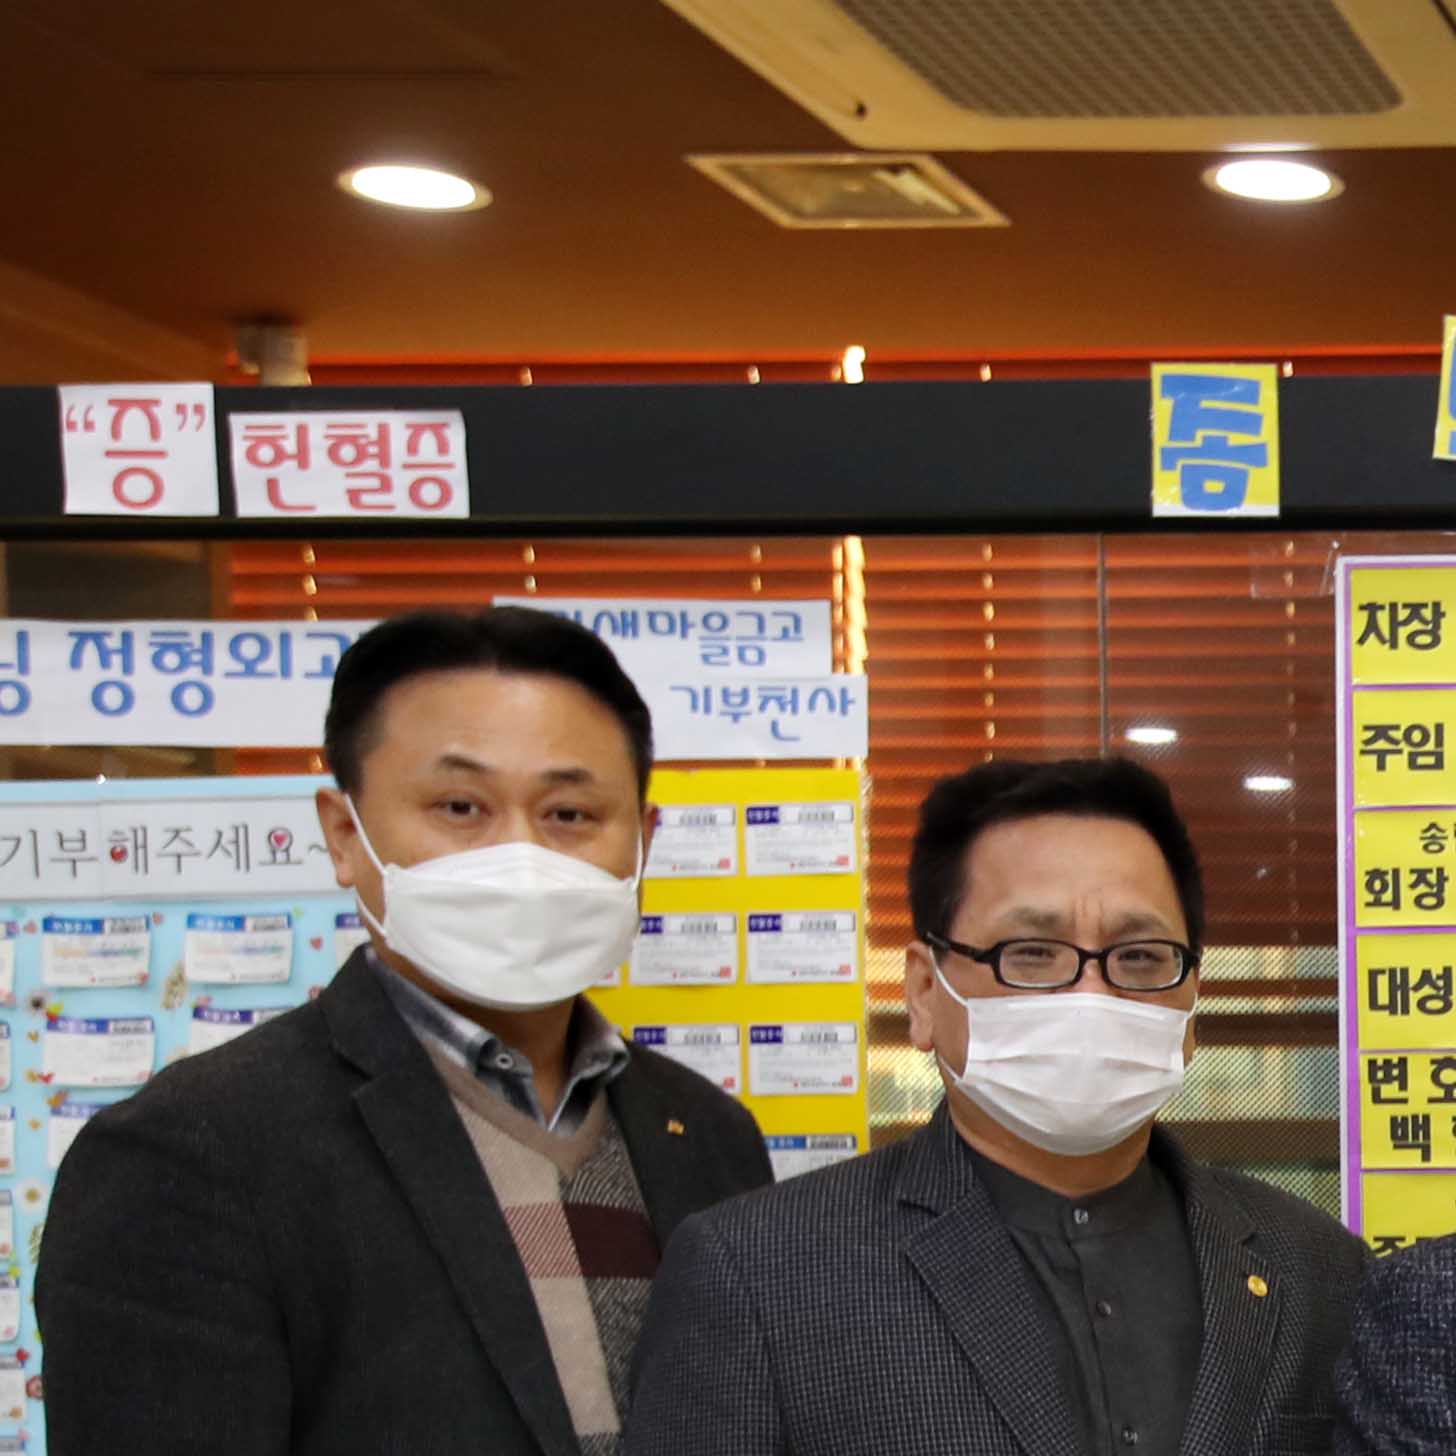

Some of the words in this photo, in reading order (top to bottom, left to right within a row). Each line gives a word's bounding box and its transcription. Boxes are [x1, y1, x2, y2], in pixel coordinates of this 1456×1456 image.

[243, 421, 456, 511] 헌혈증
[555, 608, 804, 667] 새마을금고
[670, 685, 856, 742] 기부천사
[1359, 723, 1445, 771] 주임
[1364, 866, 1449, 911] 회장
[1367, 965, 1453, 1016] 대성
